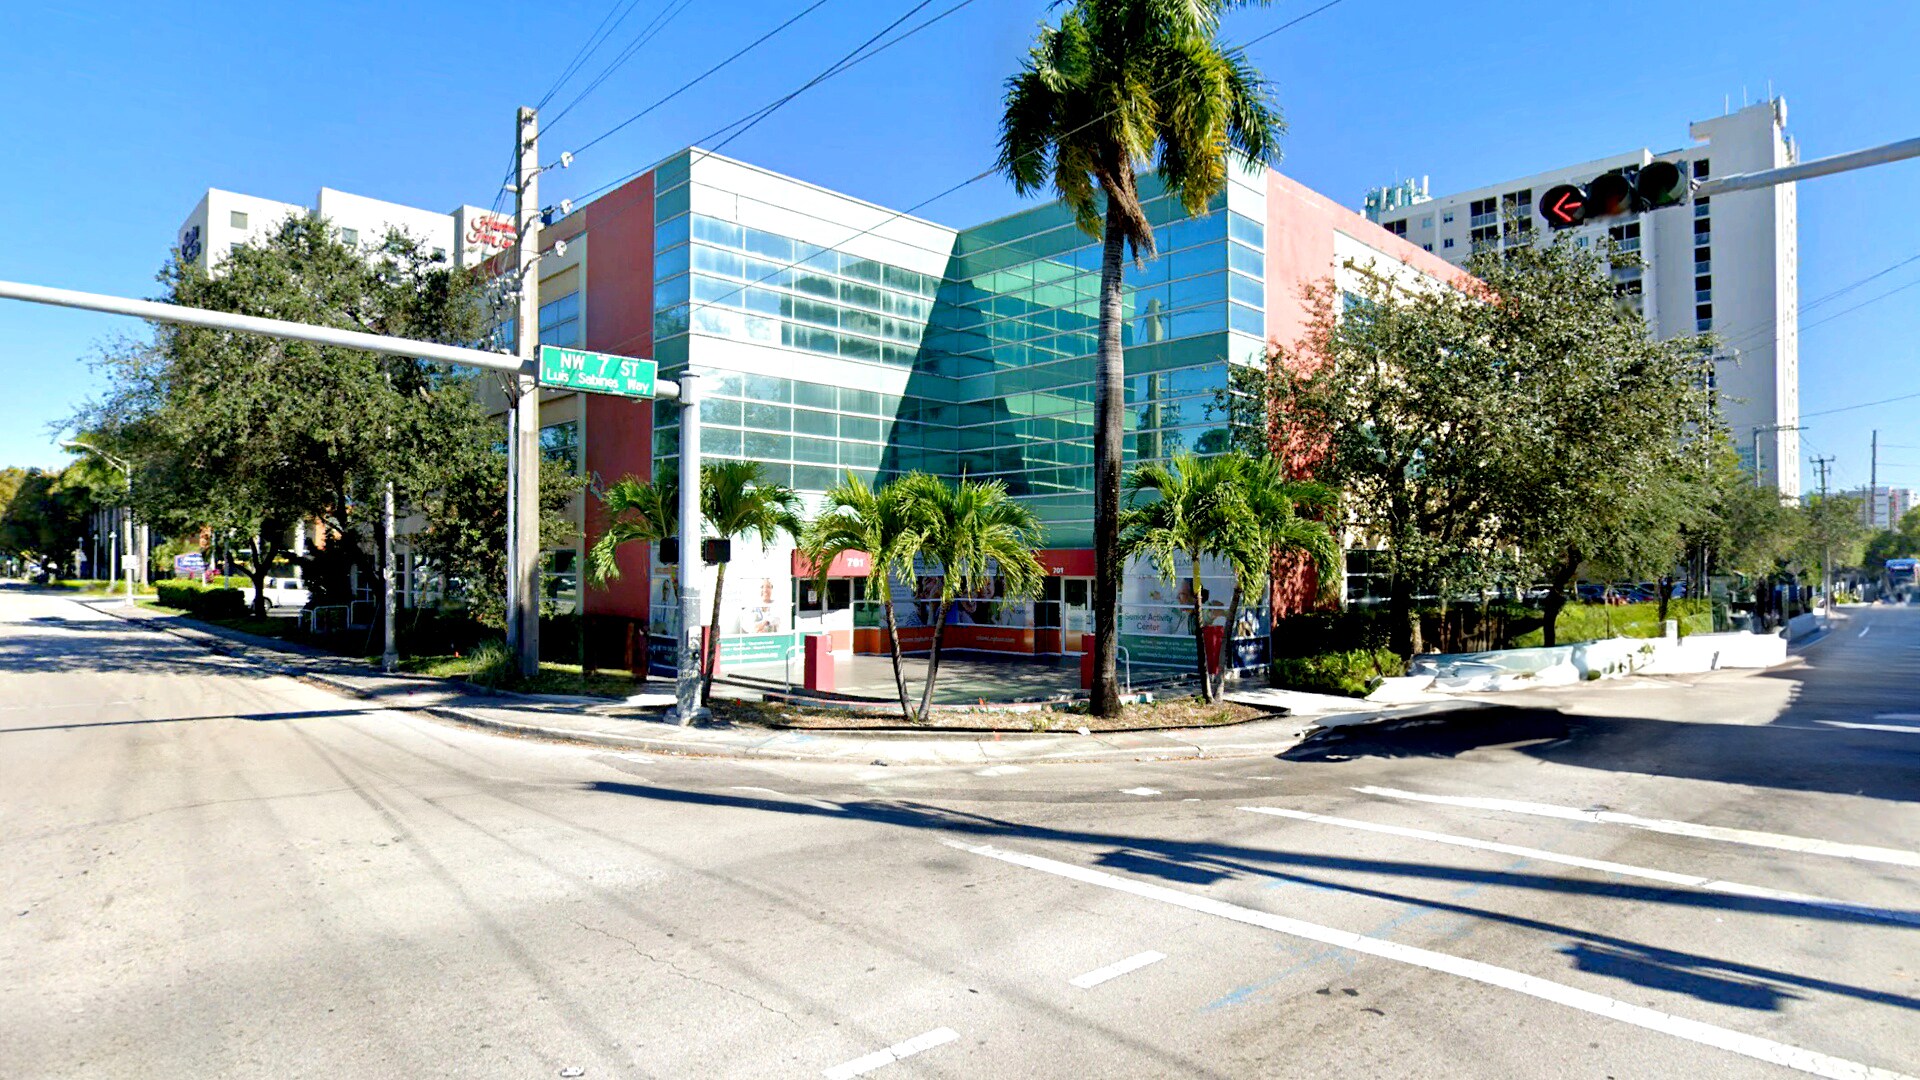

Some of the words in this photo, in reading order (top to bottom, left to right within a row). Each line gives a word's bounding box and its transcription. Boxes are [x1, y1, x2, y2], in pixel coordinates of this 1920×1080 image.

[560, 352, 585, 371] NW
[597, 356, 610, 376] 7
[620, 360, 639, 377] ST
[546, 368, 569, 383] Luis
[577, 373, 619, 389] Sabines
[627, 378, 650, 395] Way
[1125, 612, 1147, 621] Senior
[1147, 613, 1173, 623] Activity
[1136, 622, 1160, 631] Center
